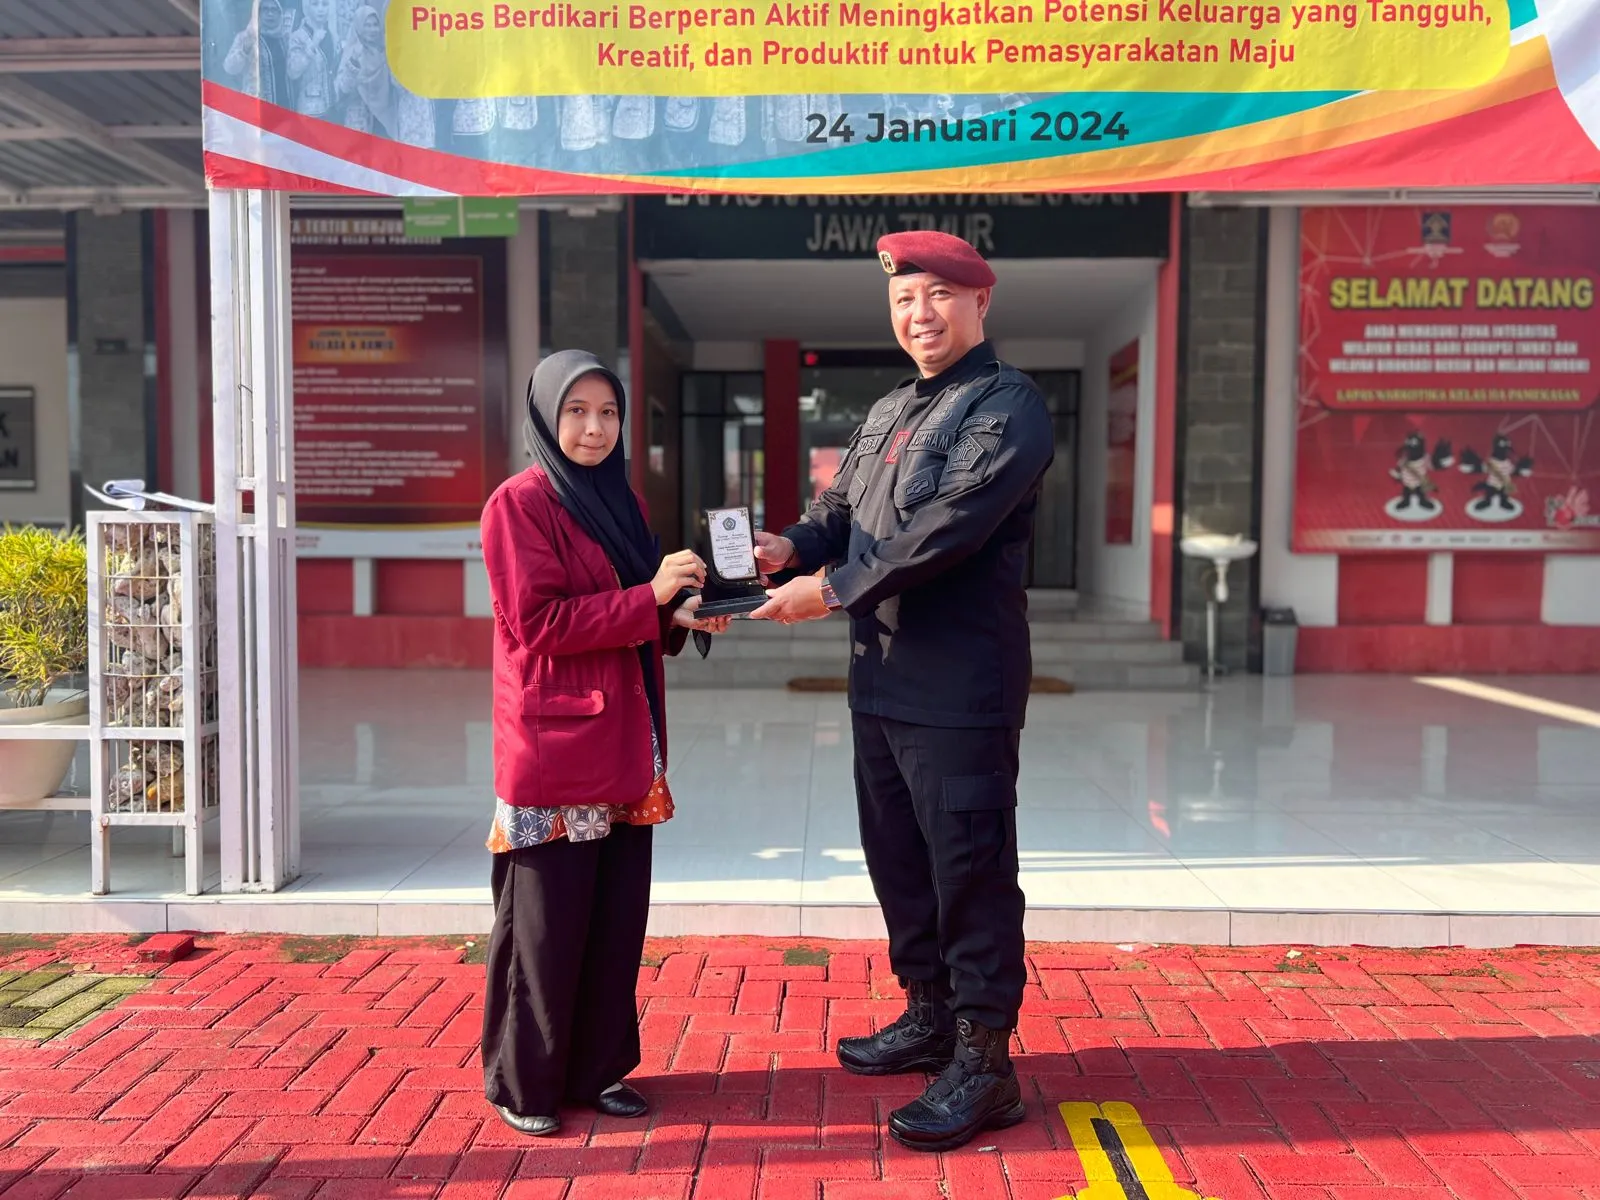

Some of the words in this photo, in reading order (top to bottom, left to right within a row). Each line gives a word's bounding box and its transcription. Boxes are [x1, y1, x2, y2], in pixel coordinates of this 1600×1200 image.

[411, 7, 484, 37] Pipas
[493, 4, 618, 29] Berdikari
[628, 4, 755, 34] Berperan
[765, 2, 829, 27] Aktif
[838, 0, 1033, 33] Meningkatkan
[1044, 0, 1147, 23] Potensi
[1158, 0, 1281, 30] Keluarga
[1291, 4, 1358, 30] yang
[1366, 0, 1492, 28] Tangguh,
[597, 42, 695, 71] Kreatif,
[704, 42, 752, 67] dan
[763, 40, 889, 65] Produktif
[899, 40, 978, 65] untuk
[986, 38, 1219, 69] Pemasyarakatan
[1229, 38, 1295, 69] Maju
[805, 113, 855, 144] 24
[865, 109, 1017, 143] Januari
[1030, 111, 1130, 142] 2024
[1330, 277, 1468, 309] SELAMAT
[1476, 277, 1594, 309] DATANG
